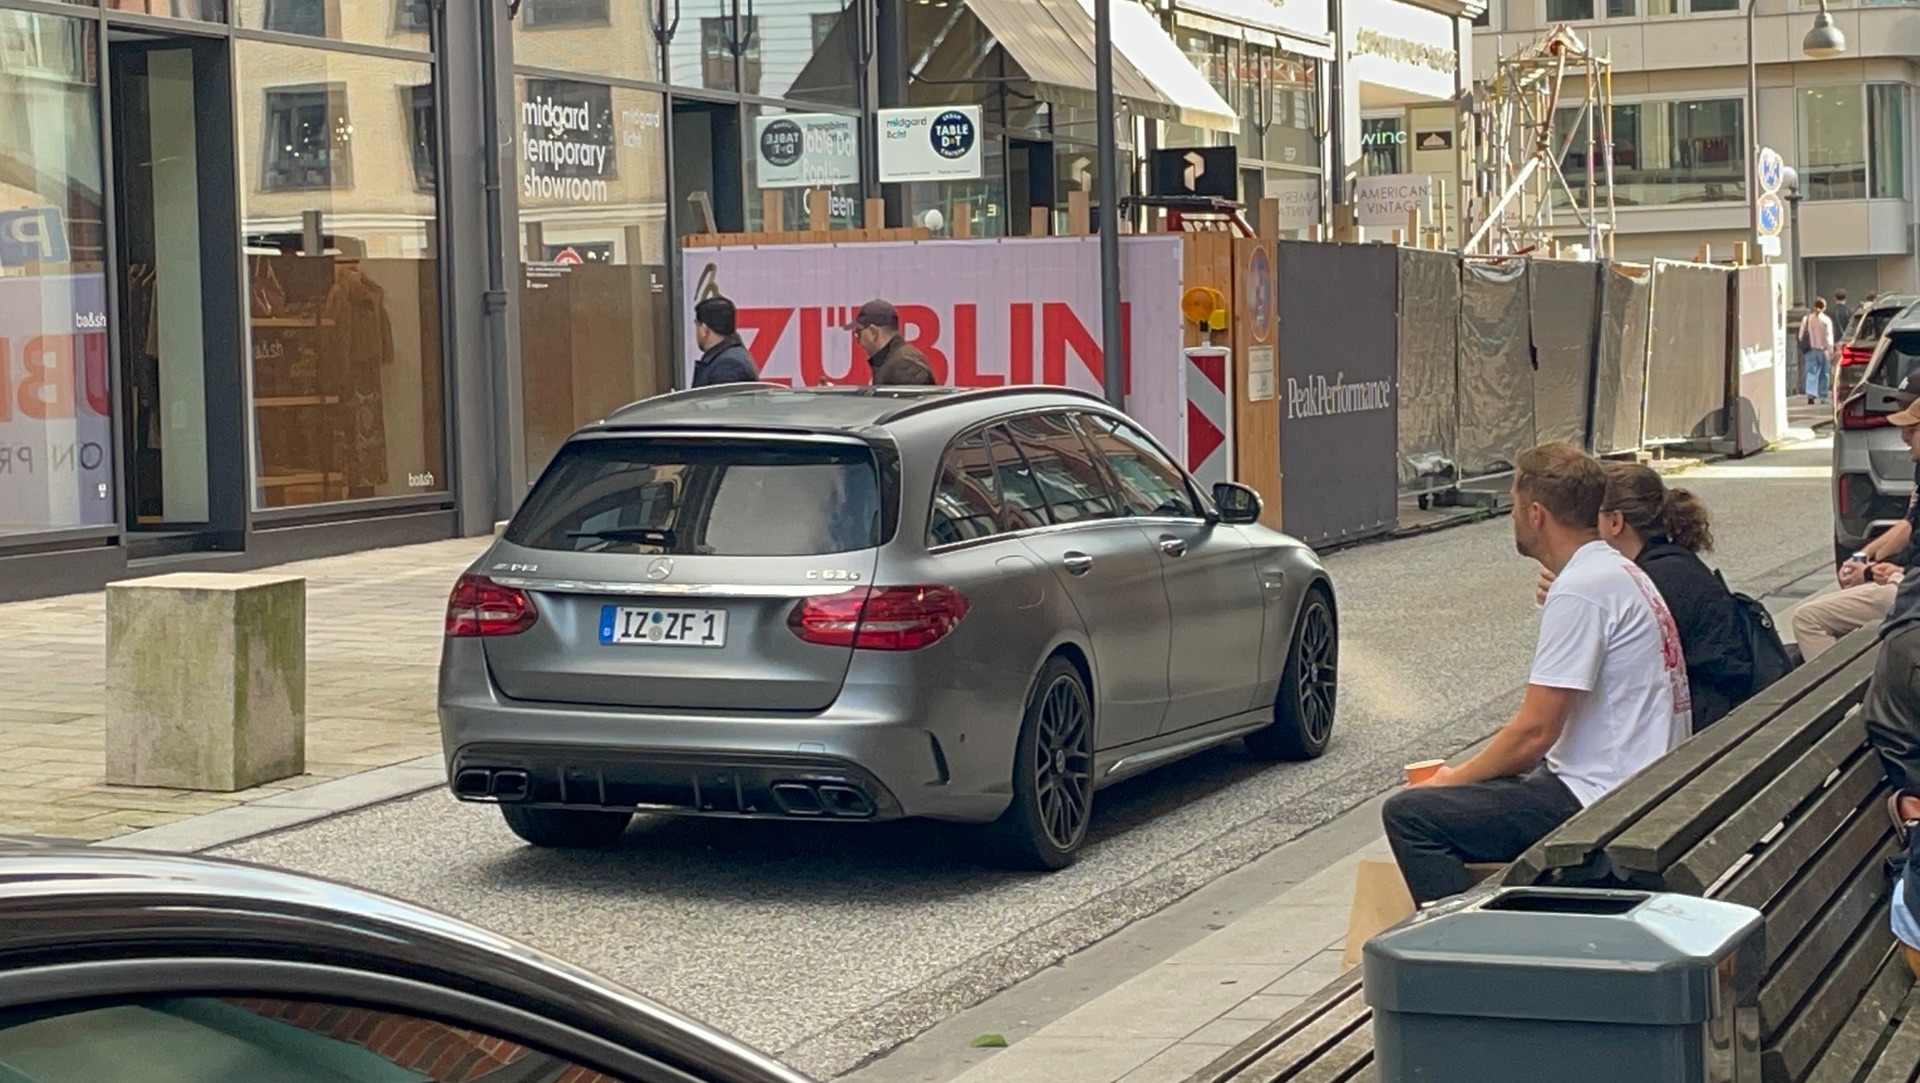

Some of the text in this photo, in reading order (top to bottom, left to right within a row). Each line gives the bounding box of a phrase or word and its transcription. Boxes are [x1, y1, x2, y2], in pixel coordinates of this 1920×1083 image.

[522, 95, 589, 136] midgard
[886, 117, 927, 128] midgard
[935, 124, 968, 136] TABLE
[523, 131, 605, 174] temporary
[524, 167, 607, 202] showroom
[1360, 186, 1427, 201] AMERICAN
[1367, 200, 1420, 214] VINTAGE
[76, 312, 107, 328] ba&sh
[732, 302, 1131, 396] ZÜBLIN
[1287, 371, 1391, 419] PeakPerformance
[621, 611, 715, 641] IZ ZF 1
